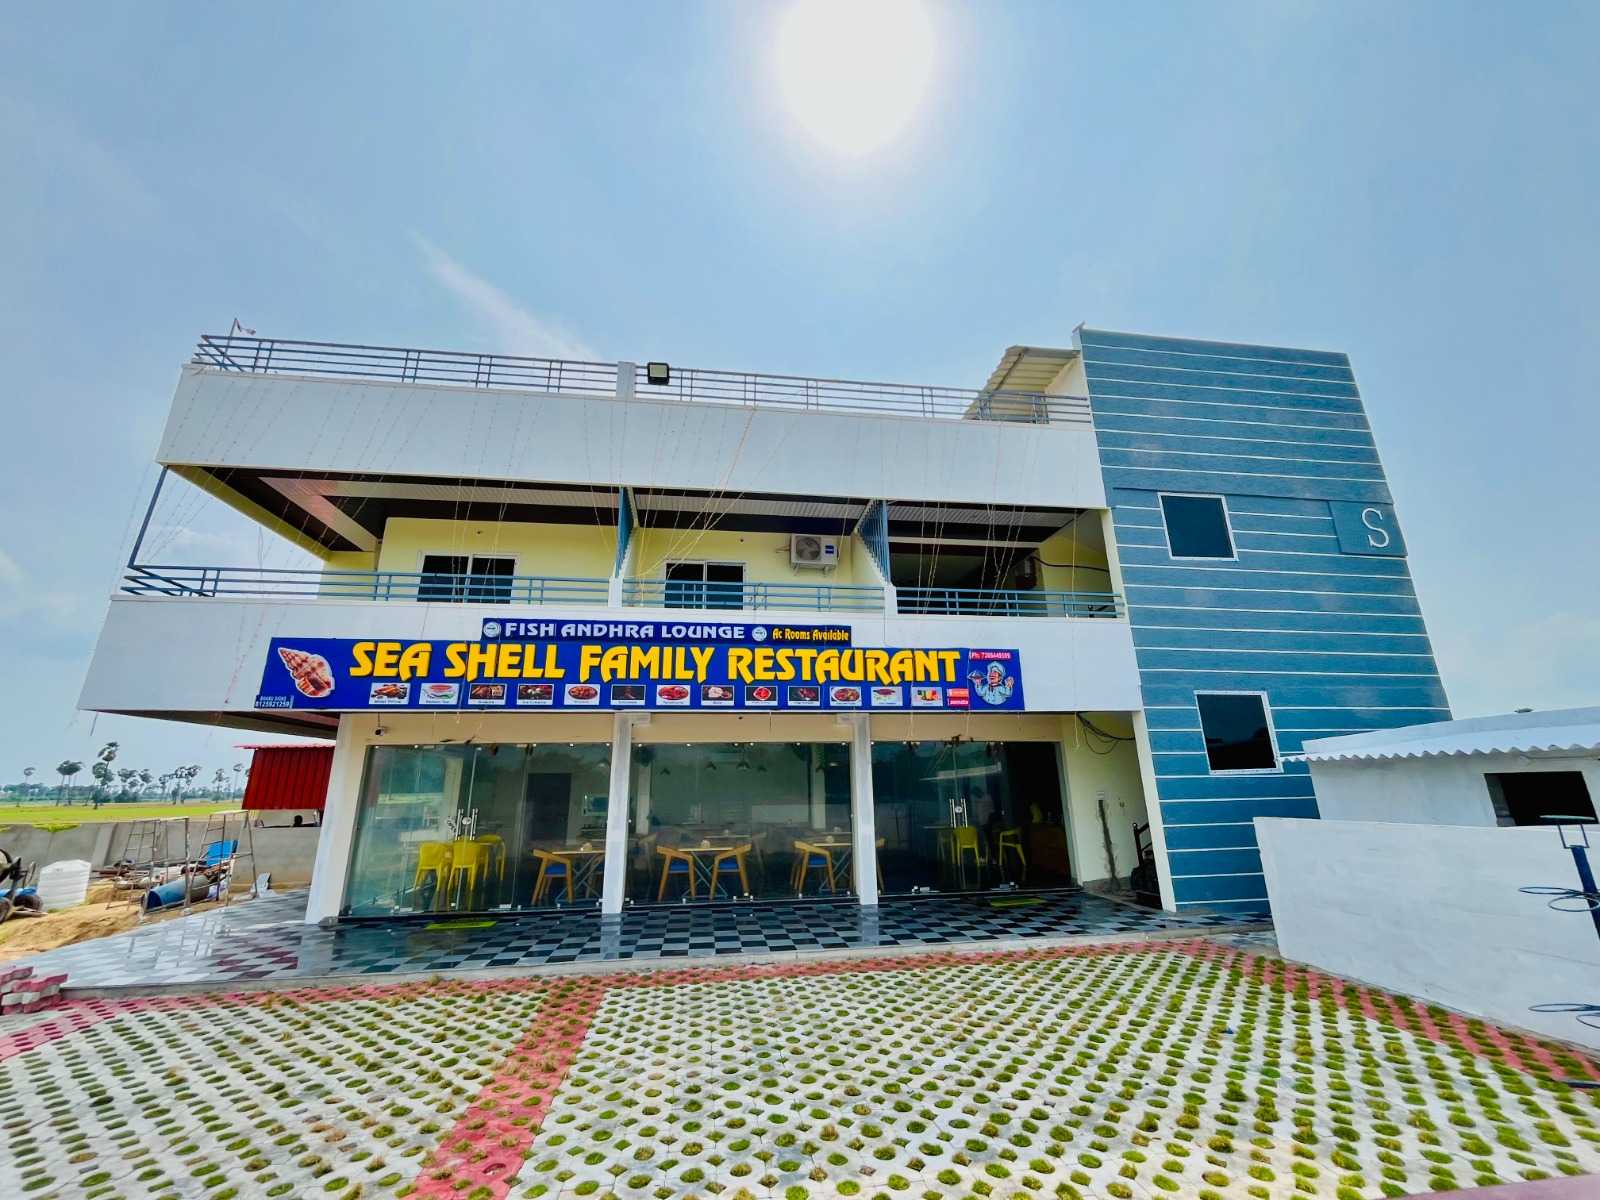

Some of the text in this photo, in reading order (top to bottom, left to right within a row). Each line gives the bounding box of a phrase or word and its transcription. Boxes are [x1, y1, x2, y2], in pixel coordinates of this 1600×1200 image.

[1362, 508, 1389, 548] S
[505, 622, 555, 638] FISH
[561, 623, 655, 639] ANDHRA
[661, 625, 746, 640] LOUNGE
[785, 628, 810, 641] Rooms
[812, 629, 850, 642] Available
[349, 641, 961, 685] SEA SHELL FAMILY RESTAURANT
